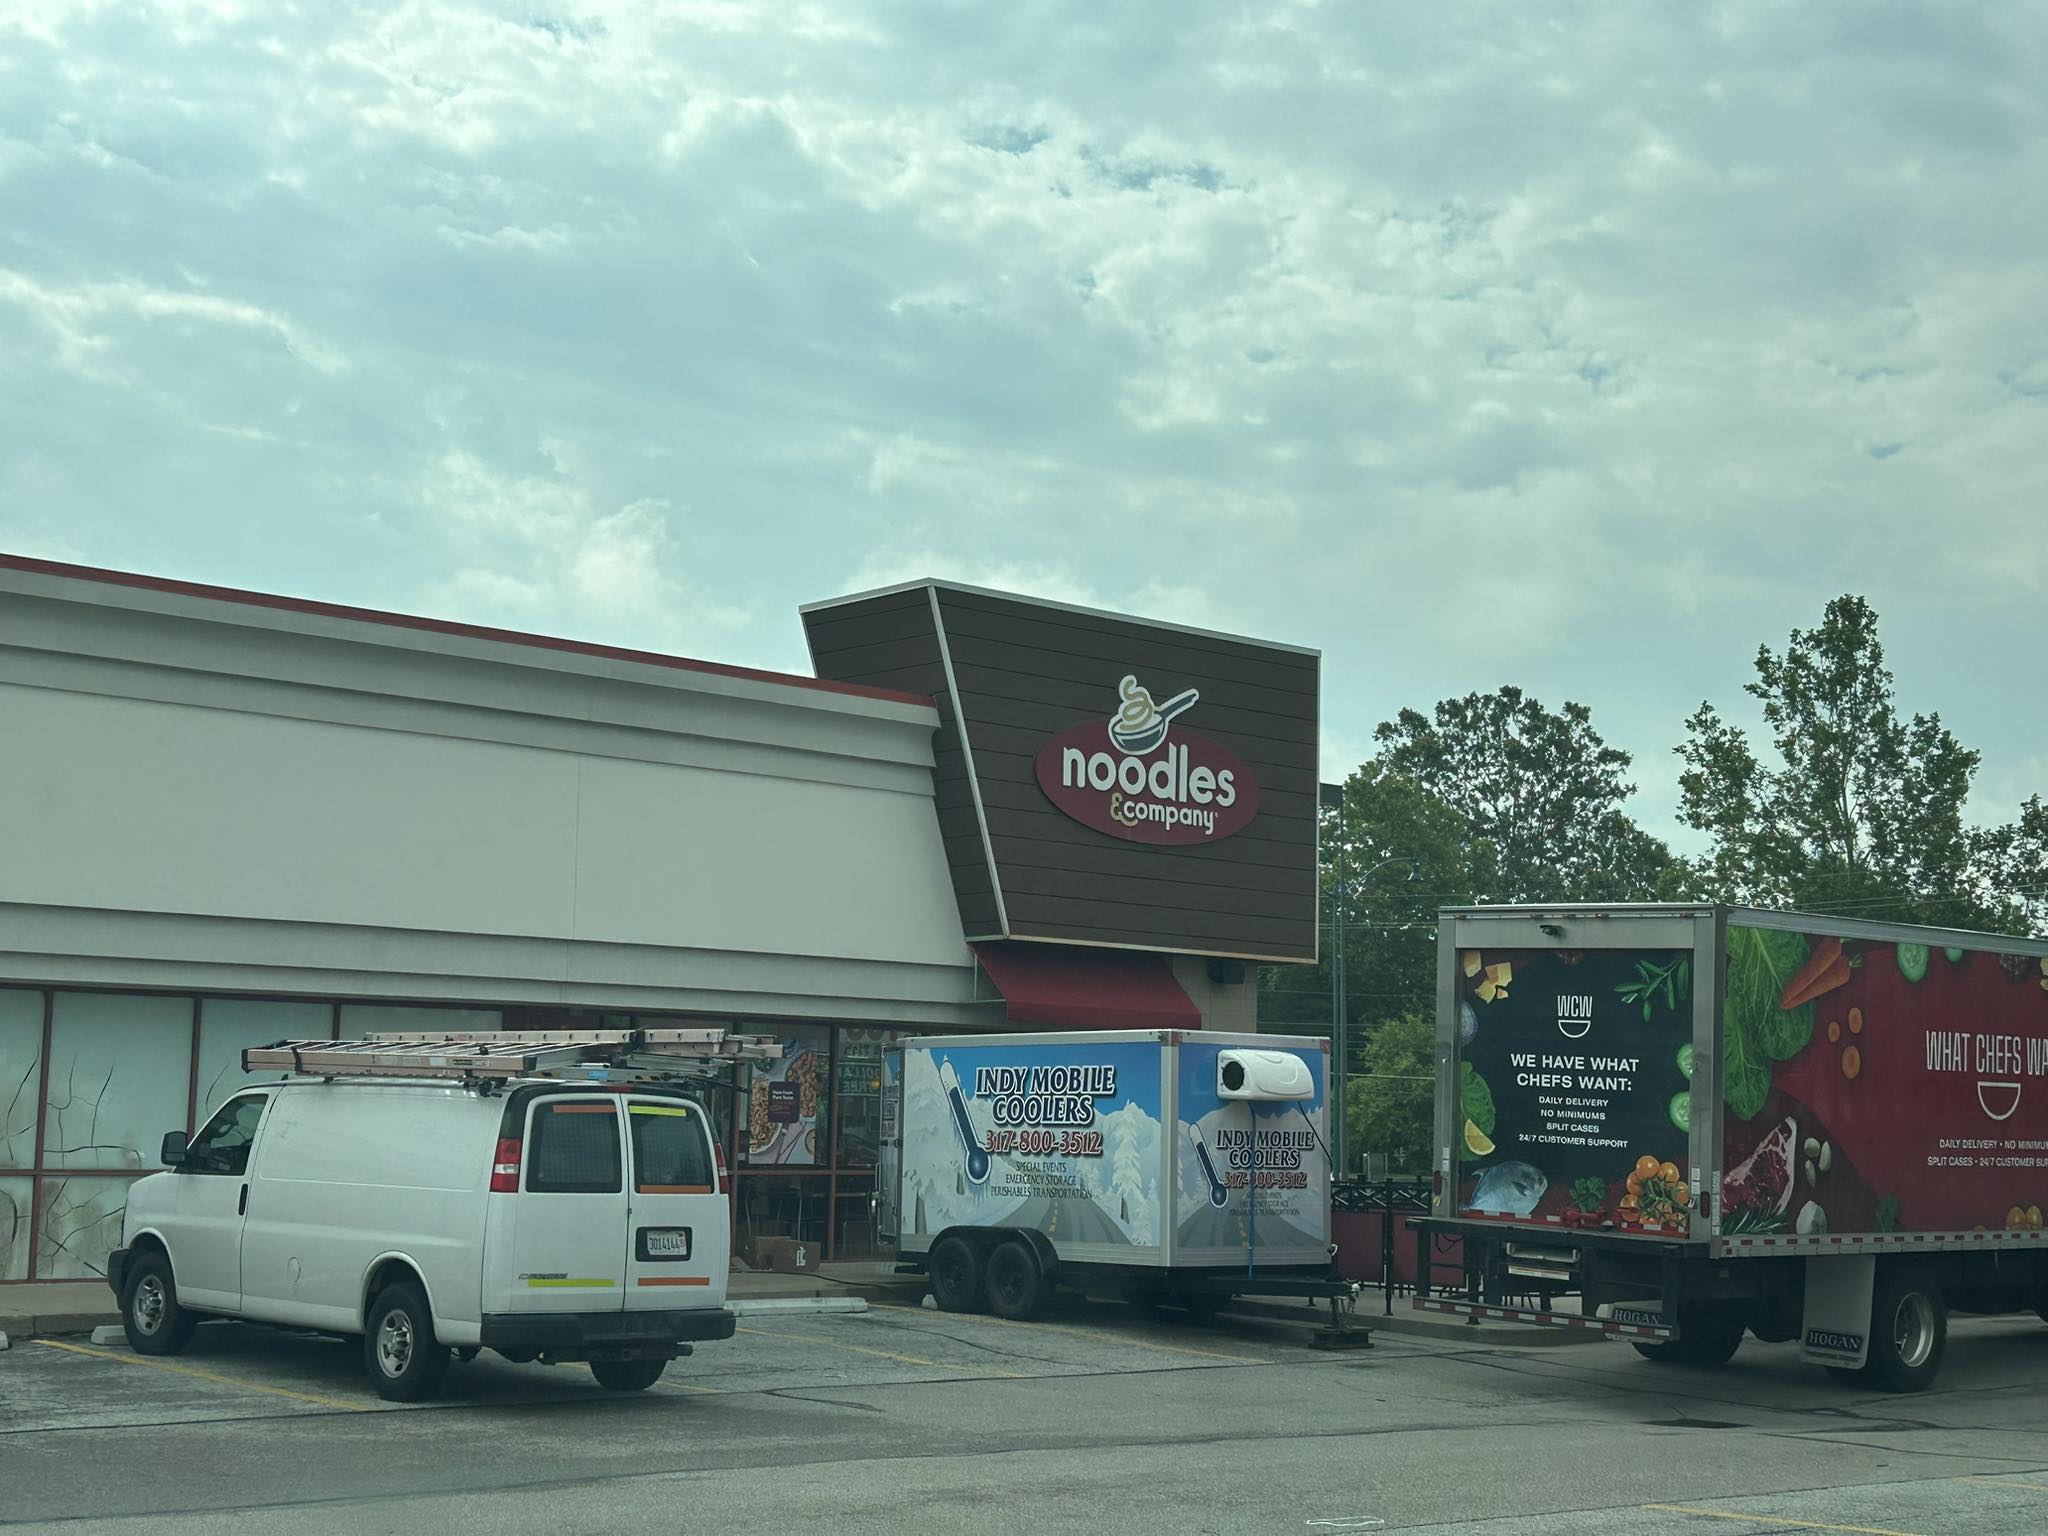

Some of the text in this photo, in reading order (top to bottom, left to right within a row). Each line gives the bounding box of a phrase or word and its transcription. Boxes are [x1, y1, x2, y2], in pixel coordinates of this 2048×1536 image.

[1062, 742, 1236, 807] noodles
[1557, 995, 1593, 1018] WCW
[1926, 1030, 1971, 1072] WHAT
[1976, 1034, 2021, 1075] CHEFS
[1510, 1053, 1639, 1072] WE HAVE WHAT
[976, 1065, 1116, 1096] INDY MOBILE
[1516, 1073, 1632, 1092] CHEFS WANT:
[992, 1095, 1094, 1125] COOLERS
[1538, 1096, 1609, 1107] DAILY DELIVERY
[1540, 1109, 1606, 1121] NO MINIMUMS
[1546, 1122, 1600, 1133] SPLIT CASES
[984, 1130, 1103, 1155] 317-800-3512
[1216, 1129, 1315, 1151] INDY MOBILE
[1518, 1133, 1629, 1149] 24/7 CUSTOMER SUPPORT
[1939, 1138, 1961, 1149] DAILY
[1962, 1140, 1997, 1149] DELIVERY
[2004, 1141, 2016, 1150] NO
[1015, 1161, 1067, 1173] SPECIAL EVENTS
[1229, 1148, 1301, 1169] COOLERS
[1927, 1156, 1947, 1166] SPLIT
[1948, 1157, 1973, 1166] CASES
[1996, 1158, 2034, 1167] CUSTOMER
[1005, 1174, 1077, 1186] EMERGENCY STORAGE
[1224, 1172, 1307, 1189] 317-00-3512
[991, 1186, 1092, 1199] PERISHABLES TRANSPORTATION
[1614, 1309, 1662, 1325] HOGAN
[1809, 1331, 1860, 1349] HOGAN
